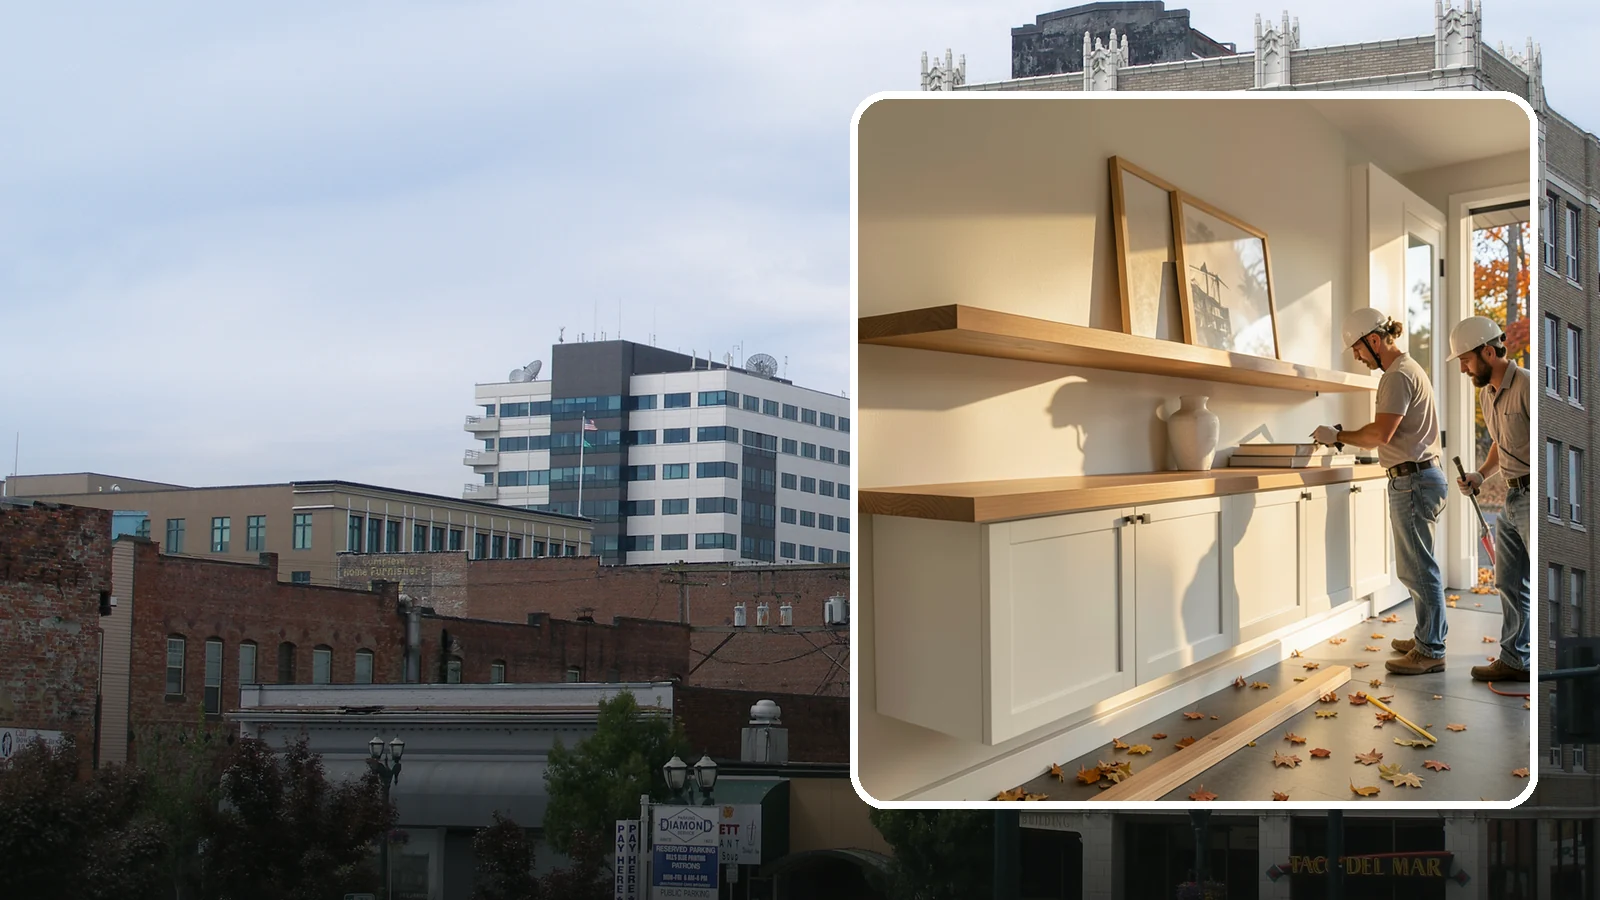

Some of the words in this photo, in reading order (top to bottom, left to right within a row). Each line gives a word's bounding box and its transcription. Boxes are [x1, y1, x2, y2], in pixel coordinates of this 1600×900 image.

[370, 566, 427, 576] Furnishers
[660, 818, 713, 832] DIAMOND
[1021, 815, 1070, 828] BUILDING
[617, 825, 625, 852] PAY
[628, 825, 637, 852] PAY
[656, 845, 688, 853] RESERVED
[689, 846, 716, 854] PARKING
[671, 862, 701, 870] PATRONS
[1345, 856, 1385, 875] DEL
[1392, 857, 1442, 877] MAR
[617, 856, 625, 893] HERE
[627, 856, 636, 893] HERE
[660, 888, 682, 897] PUBLIC
[683, 889, 710, 898] PARKING
